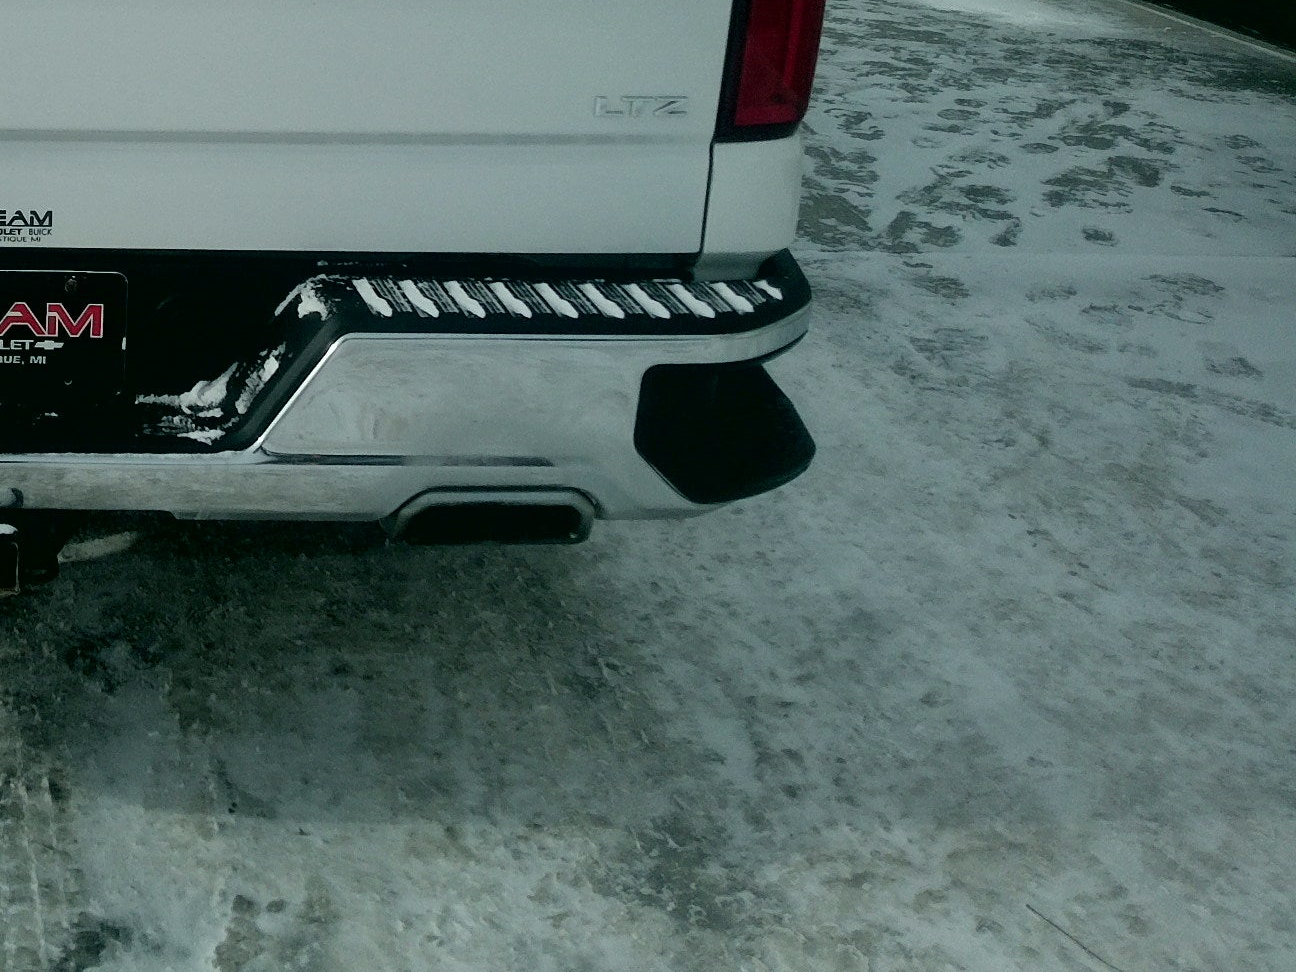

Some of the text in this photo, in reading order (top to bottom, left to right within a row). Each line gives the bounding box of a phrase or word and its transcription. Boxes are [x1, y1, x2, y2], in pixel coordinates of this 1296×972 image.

[592, 94, 689, 118] LTZ
[28, 228, 52, 236] BUICK
[29, 355, 47, 365] MI
